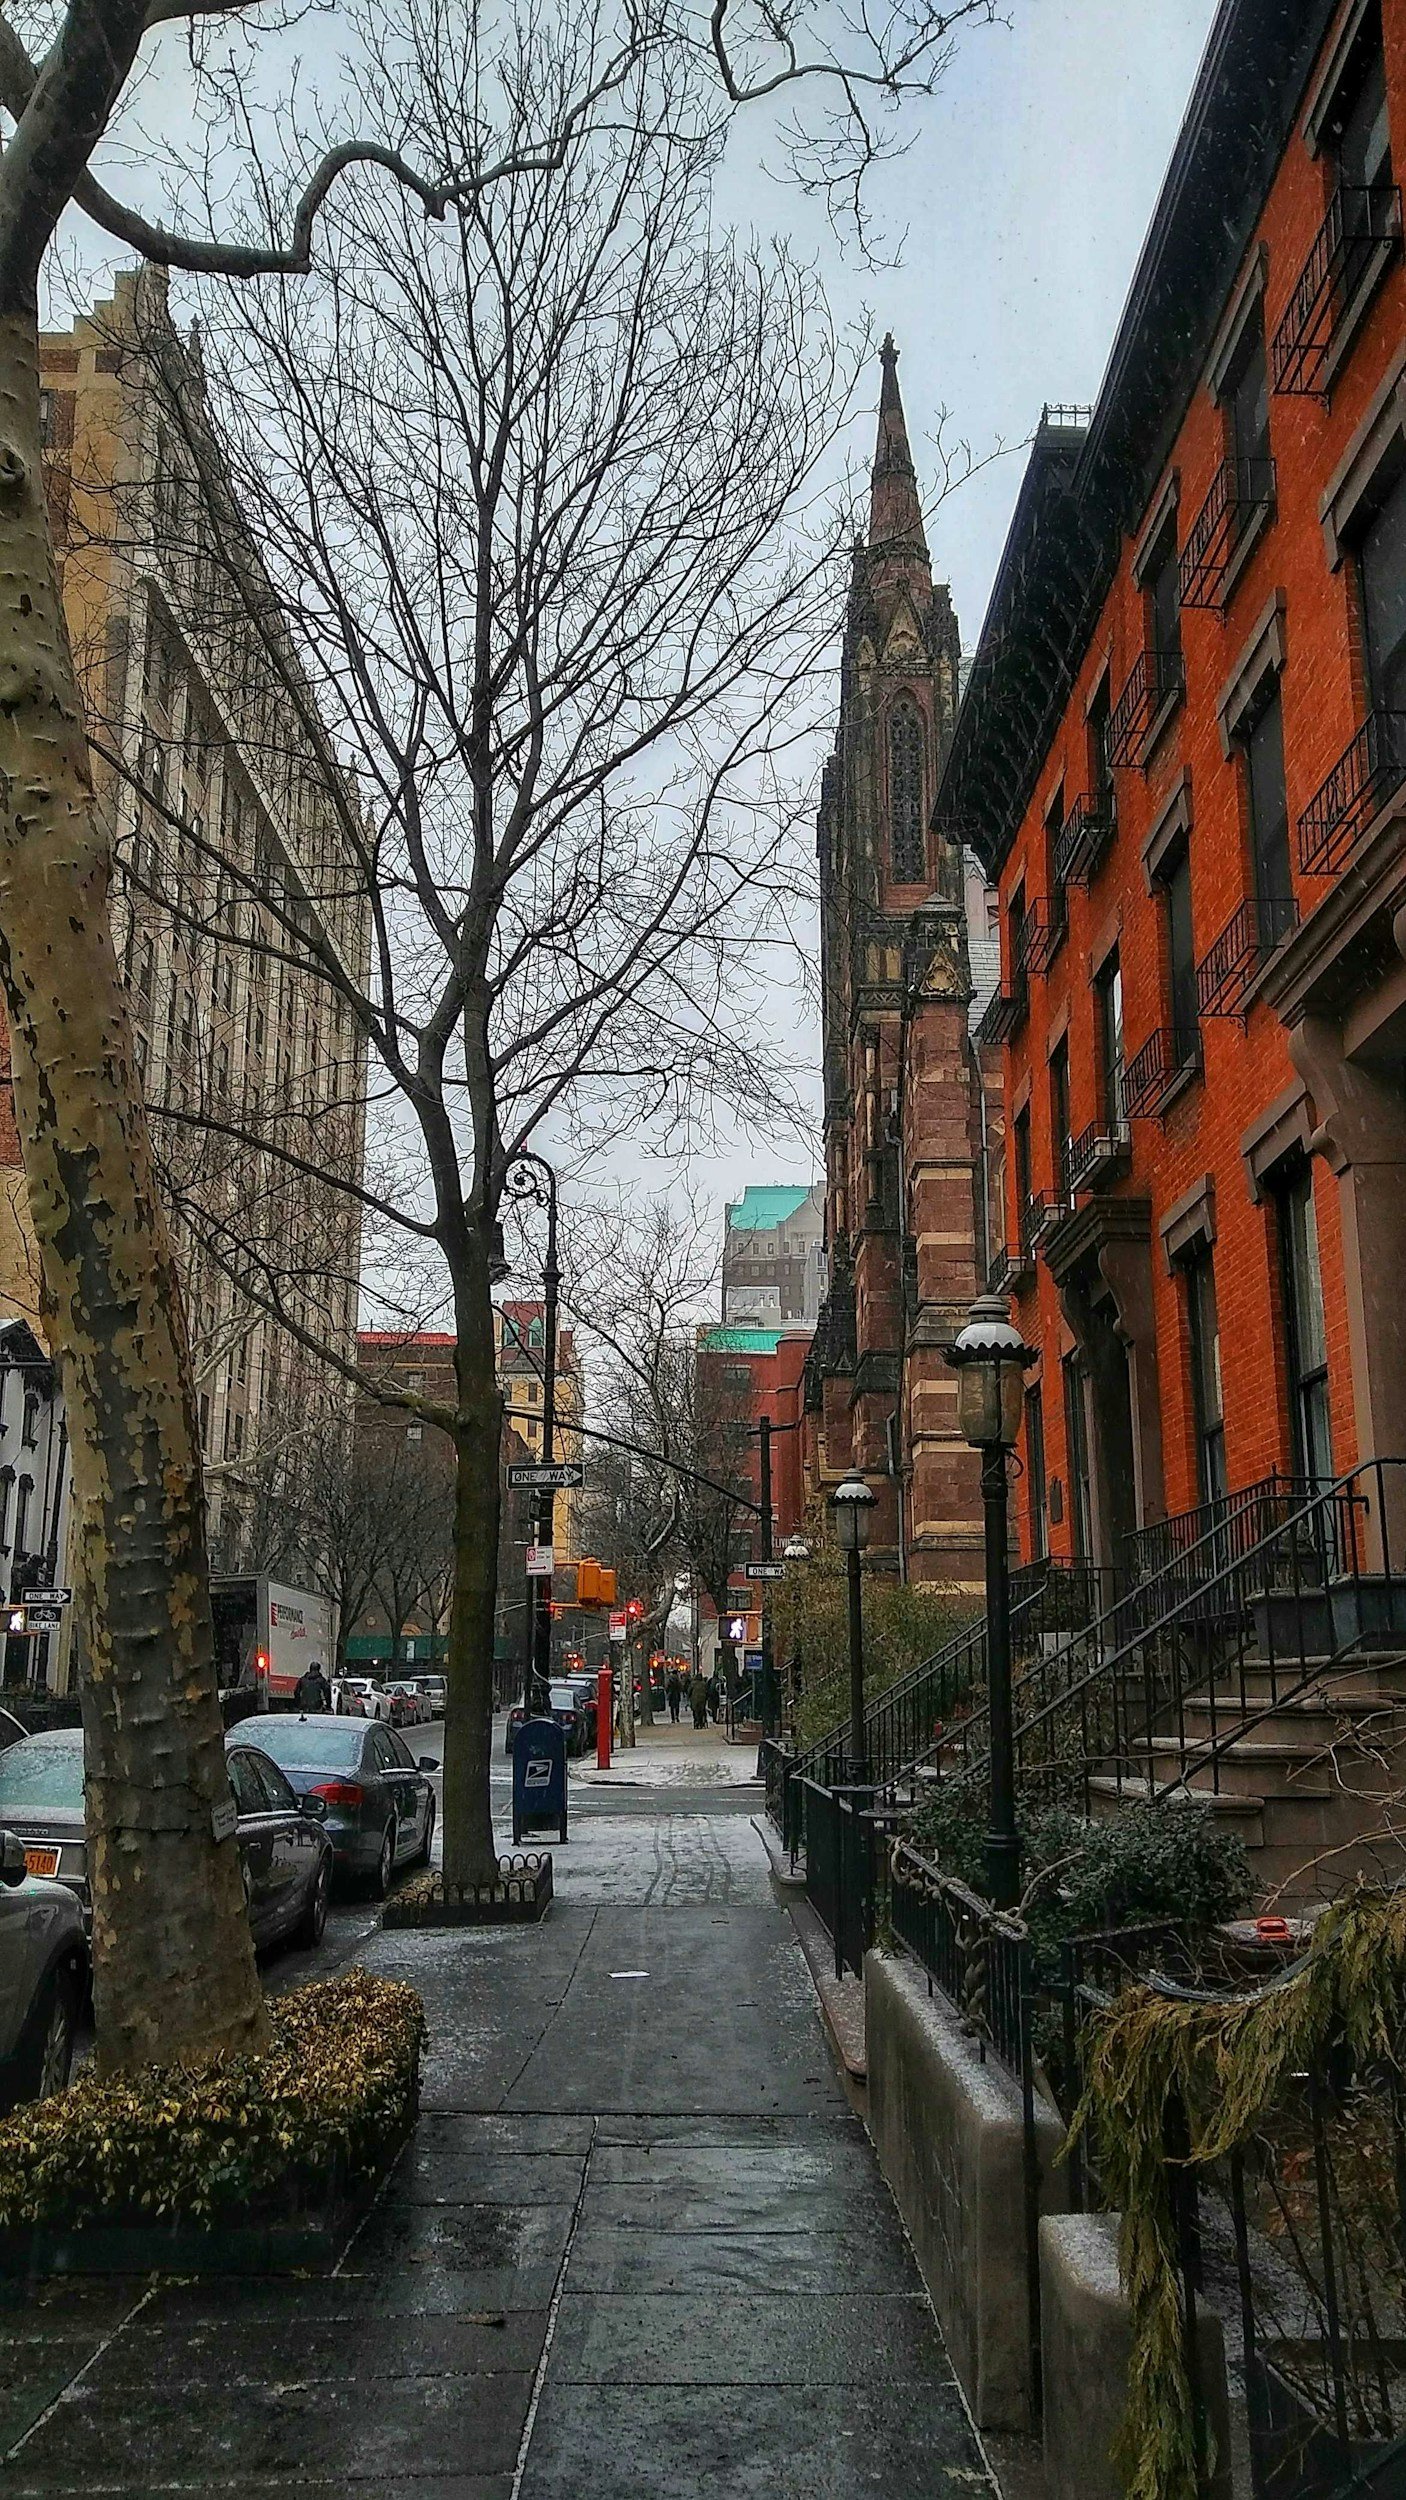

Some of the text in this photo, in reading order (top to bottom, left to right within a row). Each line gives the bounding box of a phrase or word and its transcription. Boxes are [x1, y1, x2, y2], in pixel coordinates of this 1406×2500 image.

[514, 1470, 574, 1482] ONE WAY
[775, 1537, 825, 1549] LIVION ST
[752, 1567, 767, 1575] ONE
